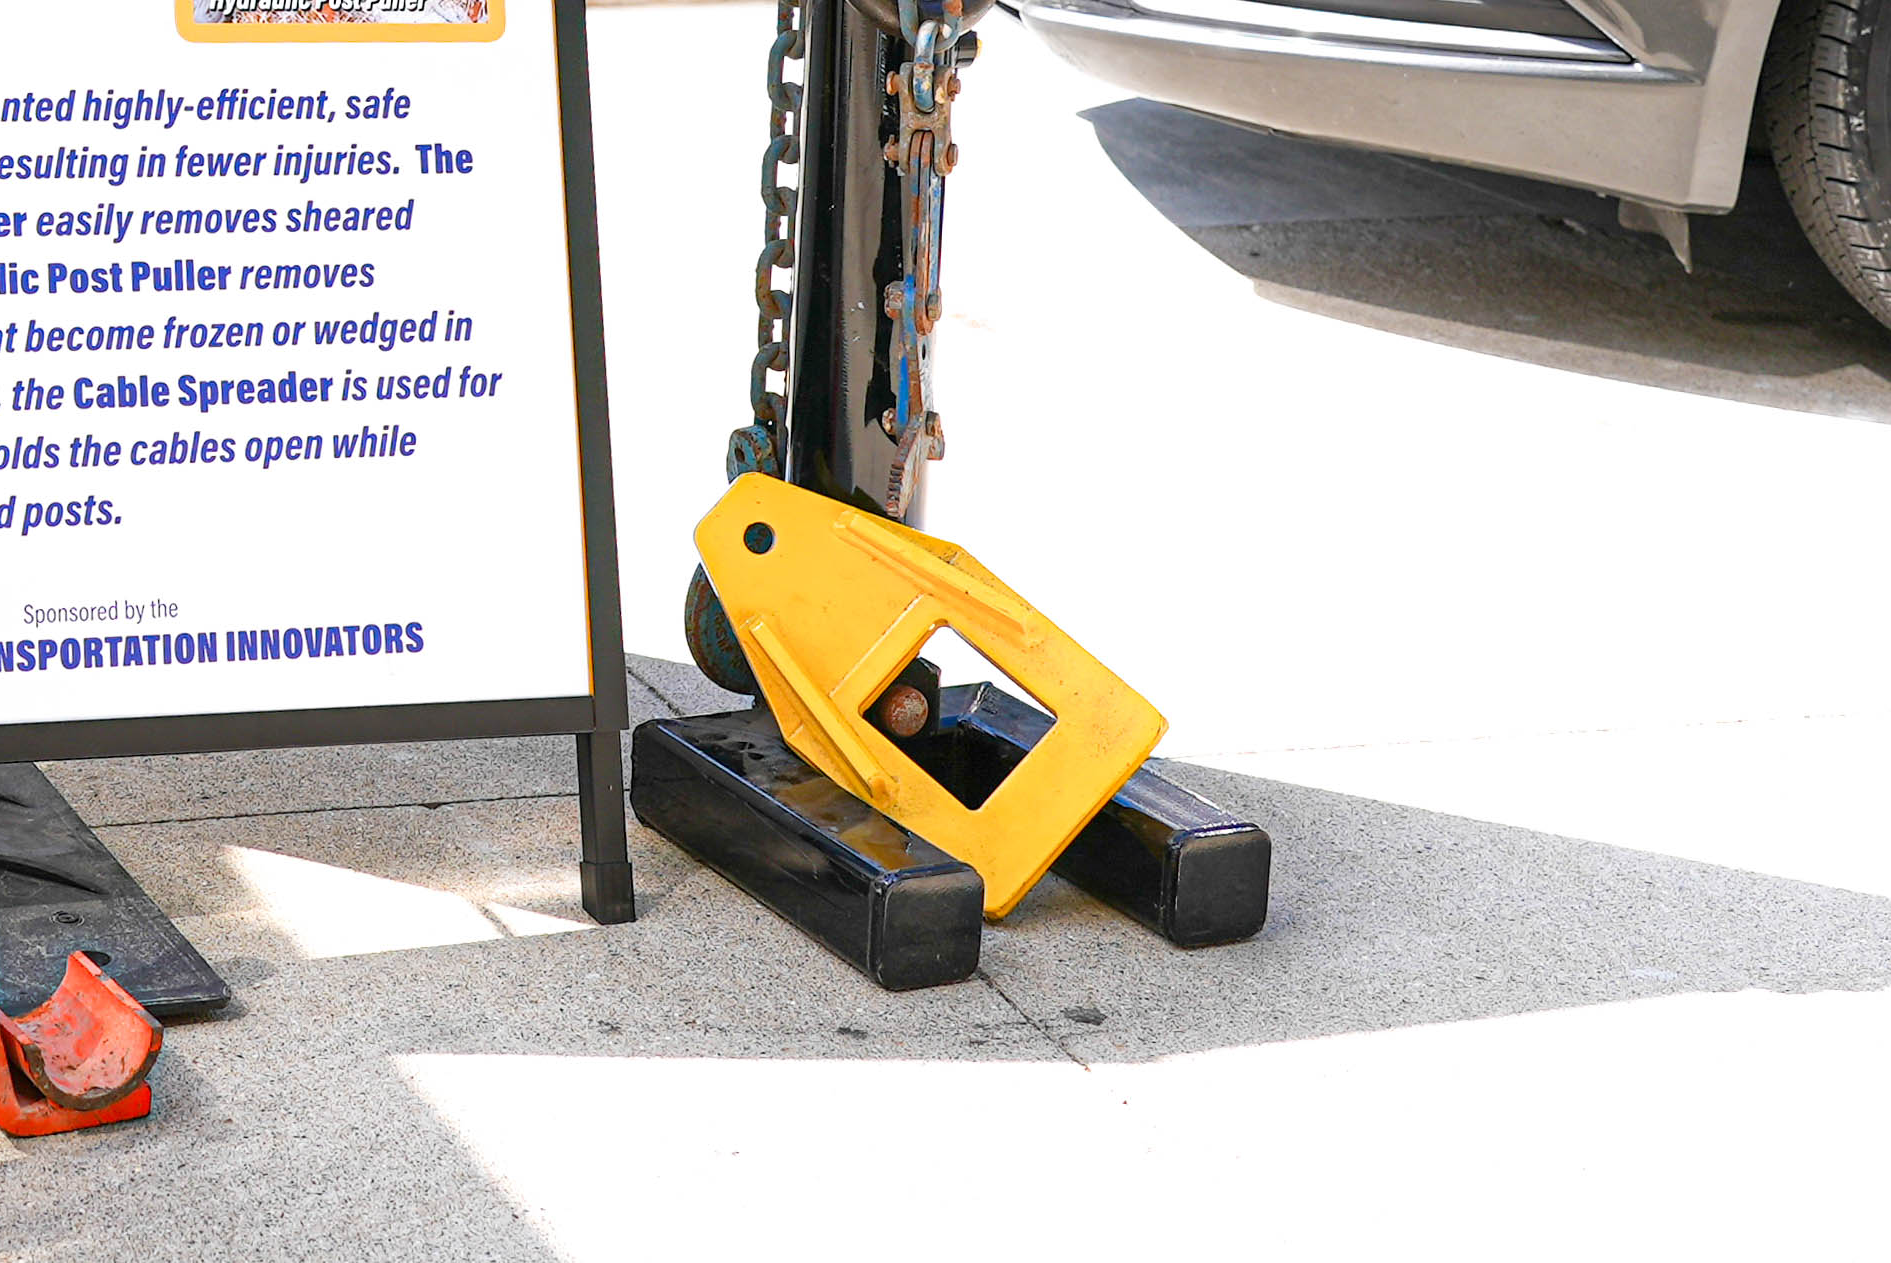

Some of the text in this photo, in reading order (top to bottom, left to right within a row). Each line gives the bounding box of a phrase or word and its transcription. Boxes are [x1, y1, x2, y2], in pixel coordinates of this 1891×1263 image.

[83, 88, 336, 130] highly-efficient,
[347, 87, 411, 120] safe
[136, 145, 167, 177] in
[176, 145, 267, 177] fewer
[274, 143, 400, 184] injuries.
[416, 143, 474, 175] The
[37, 202, 134, 244] easily
[140, 208, 278, 235] removes
[286, 199, 415, 233] sheared
[48, 262, 123, 294] Post
[130, 259, 232, 292] Puller
[240, 263, 375, 290] removes
[26, 319, 155, 353] become
[163, 316, 264, 349] frozen
[272, 321, 307, 346] or
[315, 311, 438, 352] wedged
[444, 311, 473, 342] in
[12, 377, 65, 411] the
[75, 375, 170, 410] Cable
[177, 371, 334, 413] Spreader
[343, 369, 368, 401] is
[376, 367, 452, 400] used
[460, 365, 503, 398] for
[70, 435, 122, 468] the
[131, 431, 237, 465] cables
[244, 434, 323, 469] open
[332, 424, 417, 459] while
[23, 495, 122, 536] posts.
[23, 598, 179, 628] Sponsored by the
[226, 621, 424, 662] INNOVATORS
